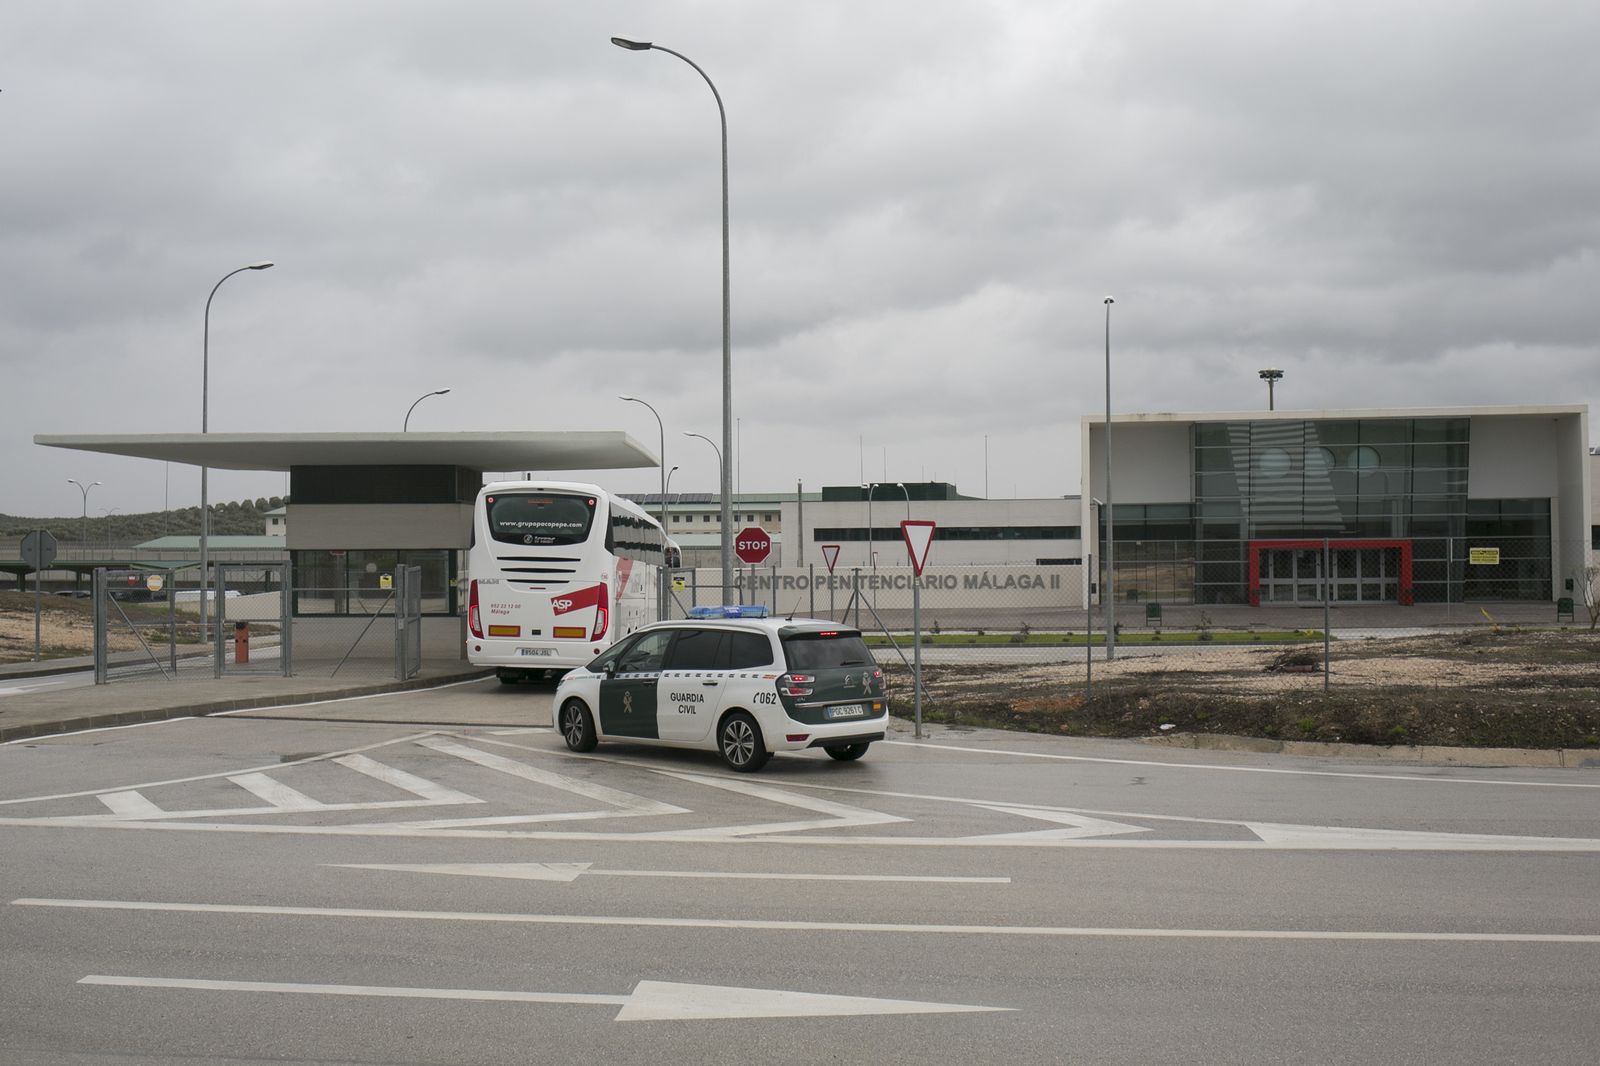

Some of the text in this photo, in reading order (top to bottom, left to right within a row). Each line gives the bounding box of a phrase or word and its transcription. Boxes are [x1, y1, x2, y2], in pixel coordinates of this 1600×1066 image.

[738, 541, 768, 550] STOP
[734, 571, 1060, 590] CENTRO PENITENCIARIO MÁLAGA II
[552, 600, 573, 609] ASP
[670, 692, 704, 703] GUARDIA
[760, 692, 777, 705] 062
[678, 704, 697, 715] CIVIL
